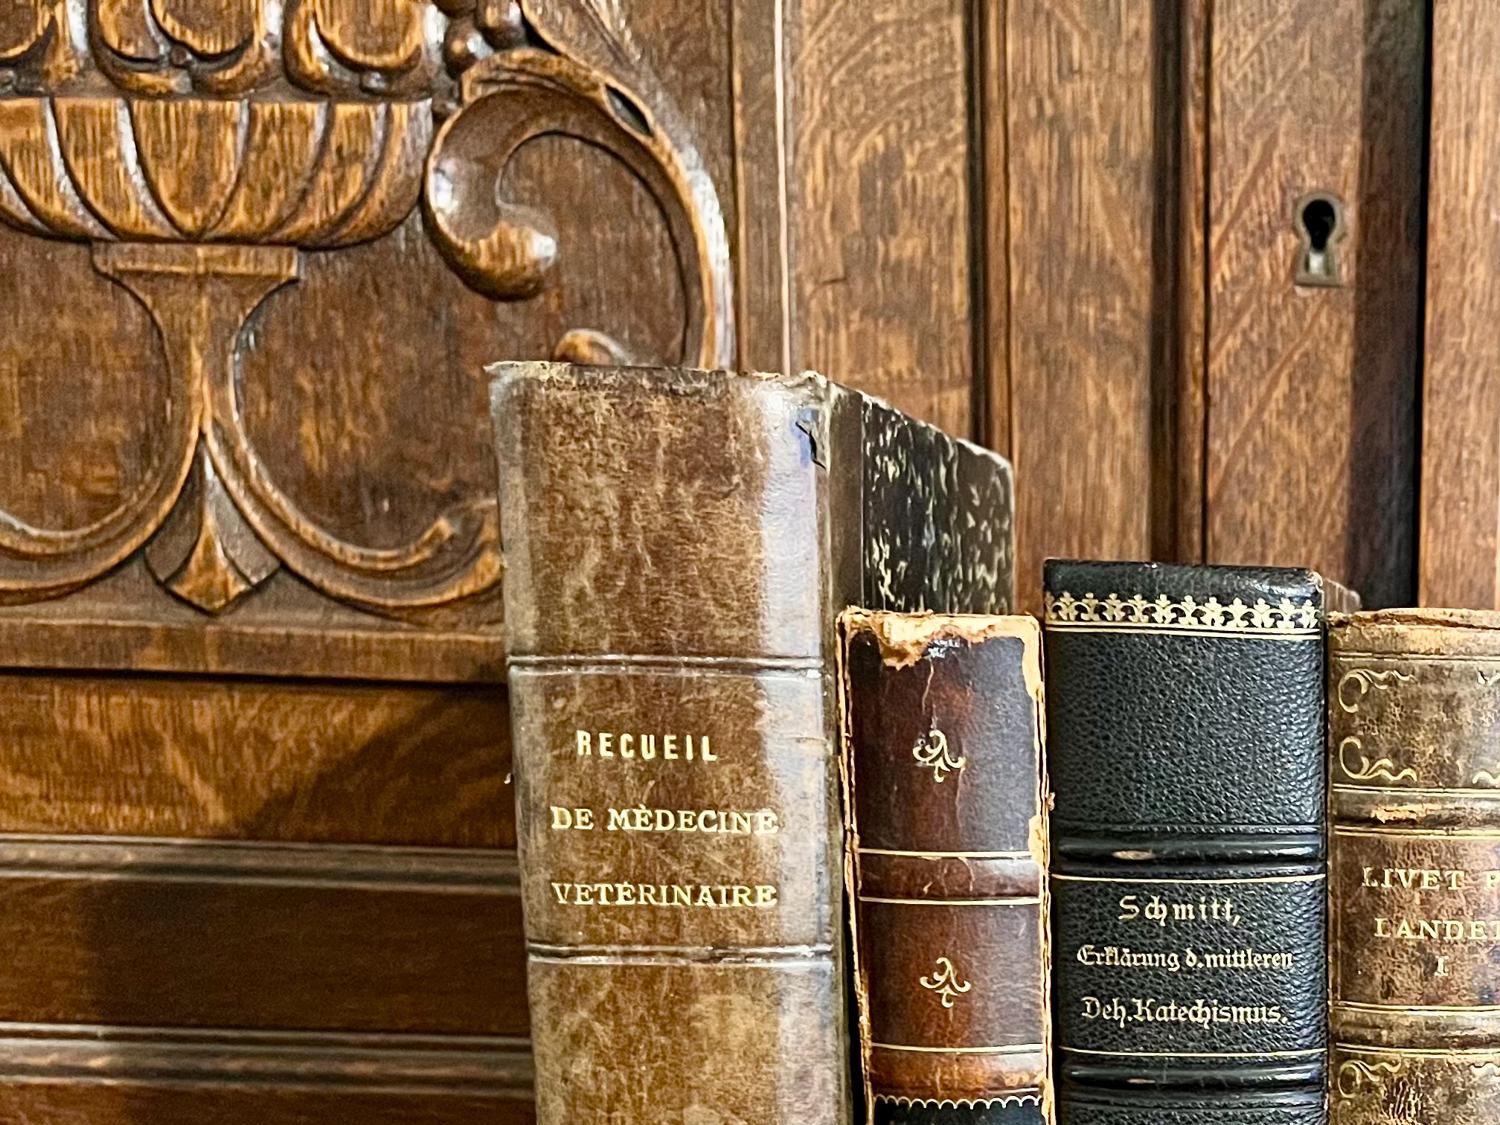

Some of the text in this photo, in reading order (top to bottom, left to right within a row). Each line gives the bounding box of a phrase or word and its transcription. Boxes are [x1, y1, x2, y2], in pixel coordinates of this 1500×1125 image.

[576, 729, 718, 762] RECUEIL
[550, 806, 595, 830] DE
[1361, 866, 1464, 890] LIVET
[1118, 894, 1241, 926] Schmitt,
[1077, 944, 1180, 972] Erklärung
[1434, 955, 1449, 977] I
